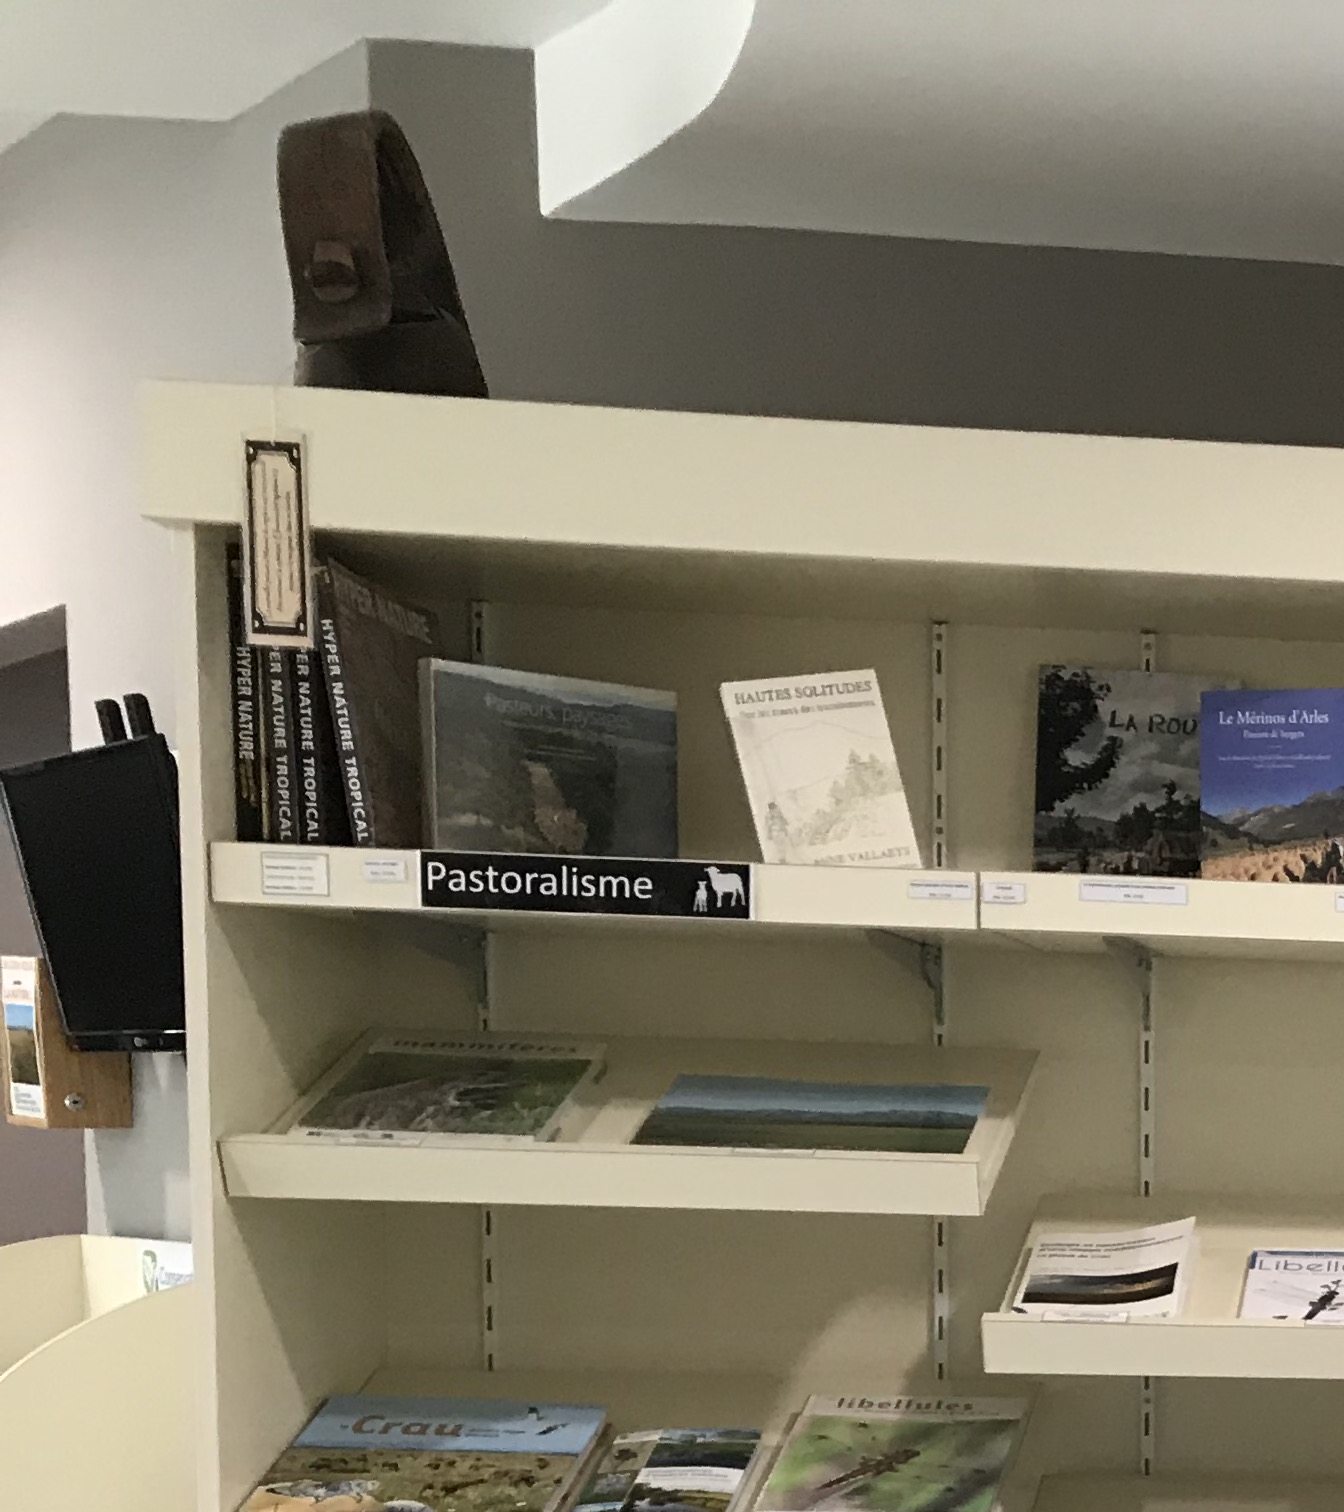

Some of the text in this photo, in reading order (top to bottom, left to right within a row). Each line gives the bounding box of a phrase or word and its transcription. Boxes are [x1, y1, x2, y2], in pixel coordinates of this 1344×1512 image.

[236, 647, 251, 695] HYPER
[734, 680, 873, 705] HAUTES SOLITUDES
[238, 701, 254, 760] NATURE
[271, 680, 287, 749] NATURE
[320, 619, 369, 841] HYPER NATURE TROPICAL
[1109, 710, 1197, 735] LA ROU
[1219, 709, 1329, 725] Le Mérinos d'Arles
[298, 682, 319, 841] NATURE TROPICAL
[276, 755, 292, 841] TROPICAL
[426, 861, 653, 899] Pastoralisme
[351, 1414, 464, 1437] Crau
[837, 1397, 974, 1411] libellules
